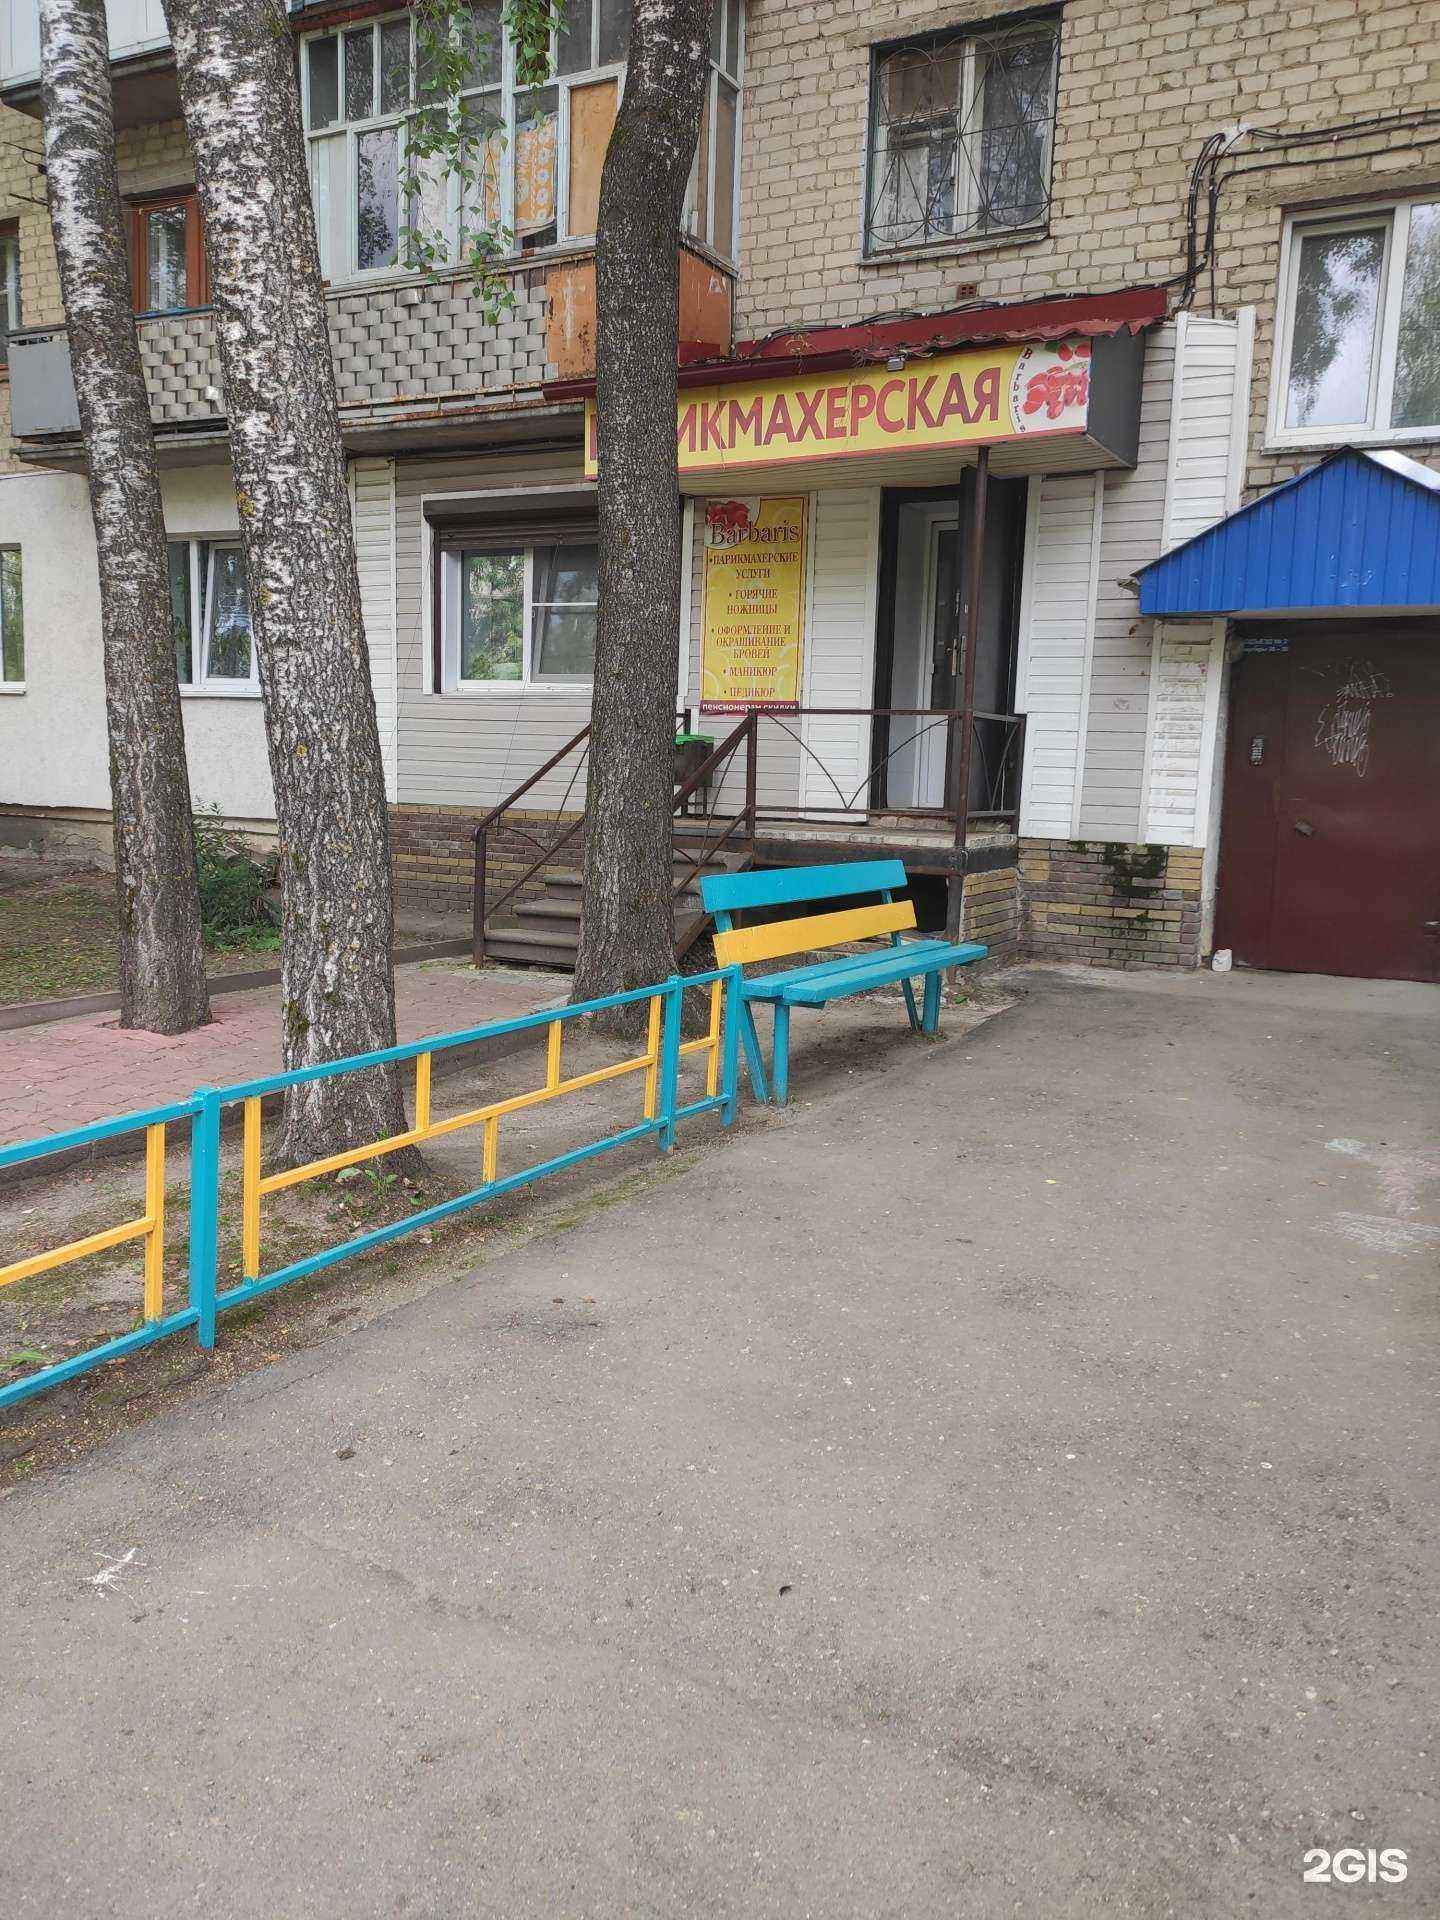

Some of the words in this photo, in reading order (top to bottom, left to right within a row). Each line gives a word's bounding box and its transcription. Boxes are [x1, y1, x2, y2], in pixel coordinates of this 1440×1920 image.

[589, 366, 1001, 461] ИКМАХЕРСКАЯ
[711, 520, 800, 545] Barbaris
[713, 551, 799, 565] ПАРИКМАХЕРСКИЕ
[736, 568, 770, 579] УСЛУГИ
[735, 588, 778, 600] ГОРЯЧИЕ
[727, 604, 778, 615] НОЖНИЦЫ
[717, 624, 782, 635] ОФОРМЛЕНИЕ
[784, 624, 791, 635] И
[716, 636, 786, 647] ОКРАШИВАНИЕ
[733, 647, 770, 659] БРОВЕЙ
[729, 666, 778, 677] МАНИКЮР
[730, 687, 776, 698] ПЕДИКЮР
